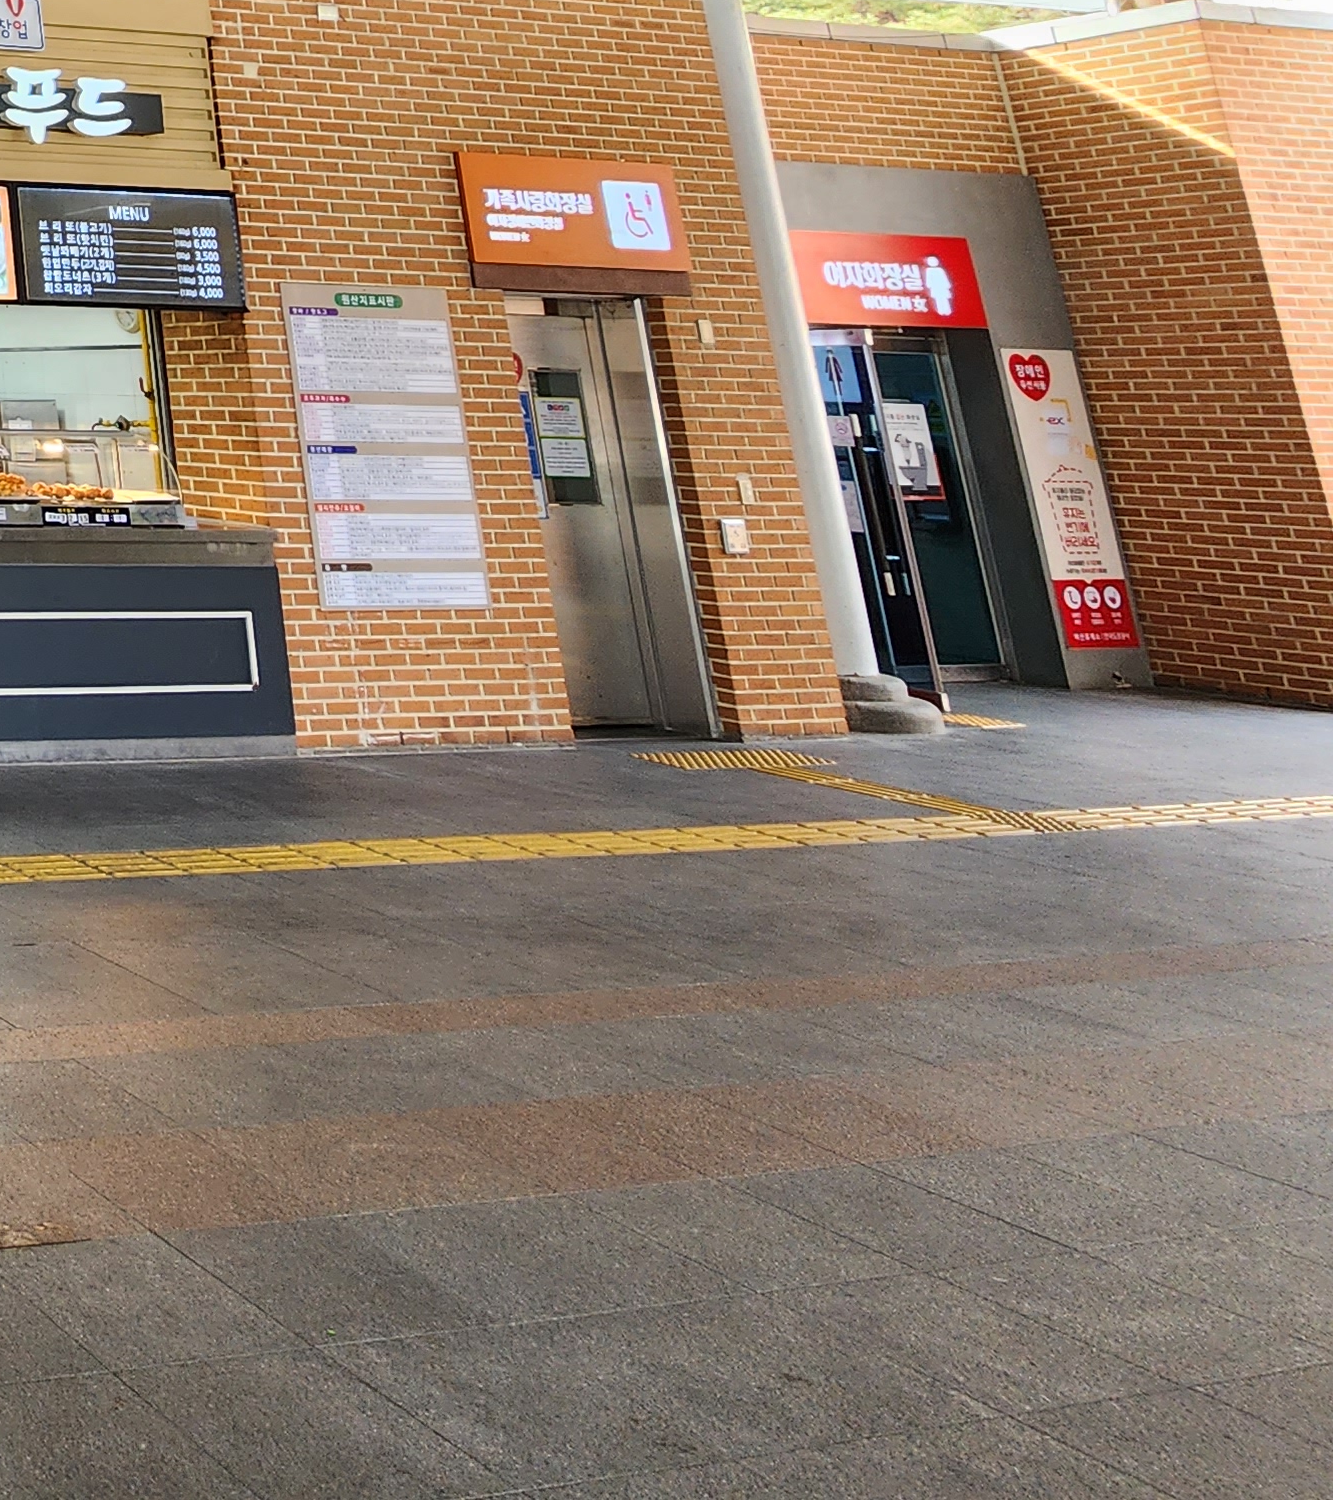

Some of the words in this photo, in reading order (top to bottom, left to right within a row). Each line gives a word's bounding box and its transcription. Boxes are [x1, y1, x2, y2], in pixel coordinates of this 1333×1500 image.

[482, 188, 594, 215] 가족사랑화장실
[108, 205, 150, 221] MENU
[192, 226, 216, 238] 6,000
[193, 238, 218, 250] 6,000
[194, 250, 219, 262] 3,500
[196, 262, 221, 274] 4,500
[197, 275, 222, 286] 3,000
[823, 261, 924, 291] 여자화장실
[199, 287, 224, 299] 4,000
[341, 294, 395, 307] 원산지표시판
[861, 294, 912, 311] WOMEN
[1015, 364, 1045, 378] 장애인
